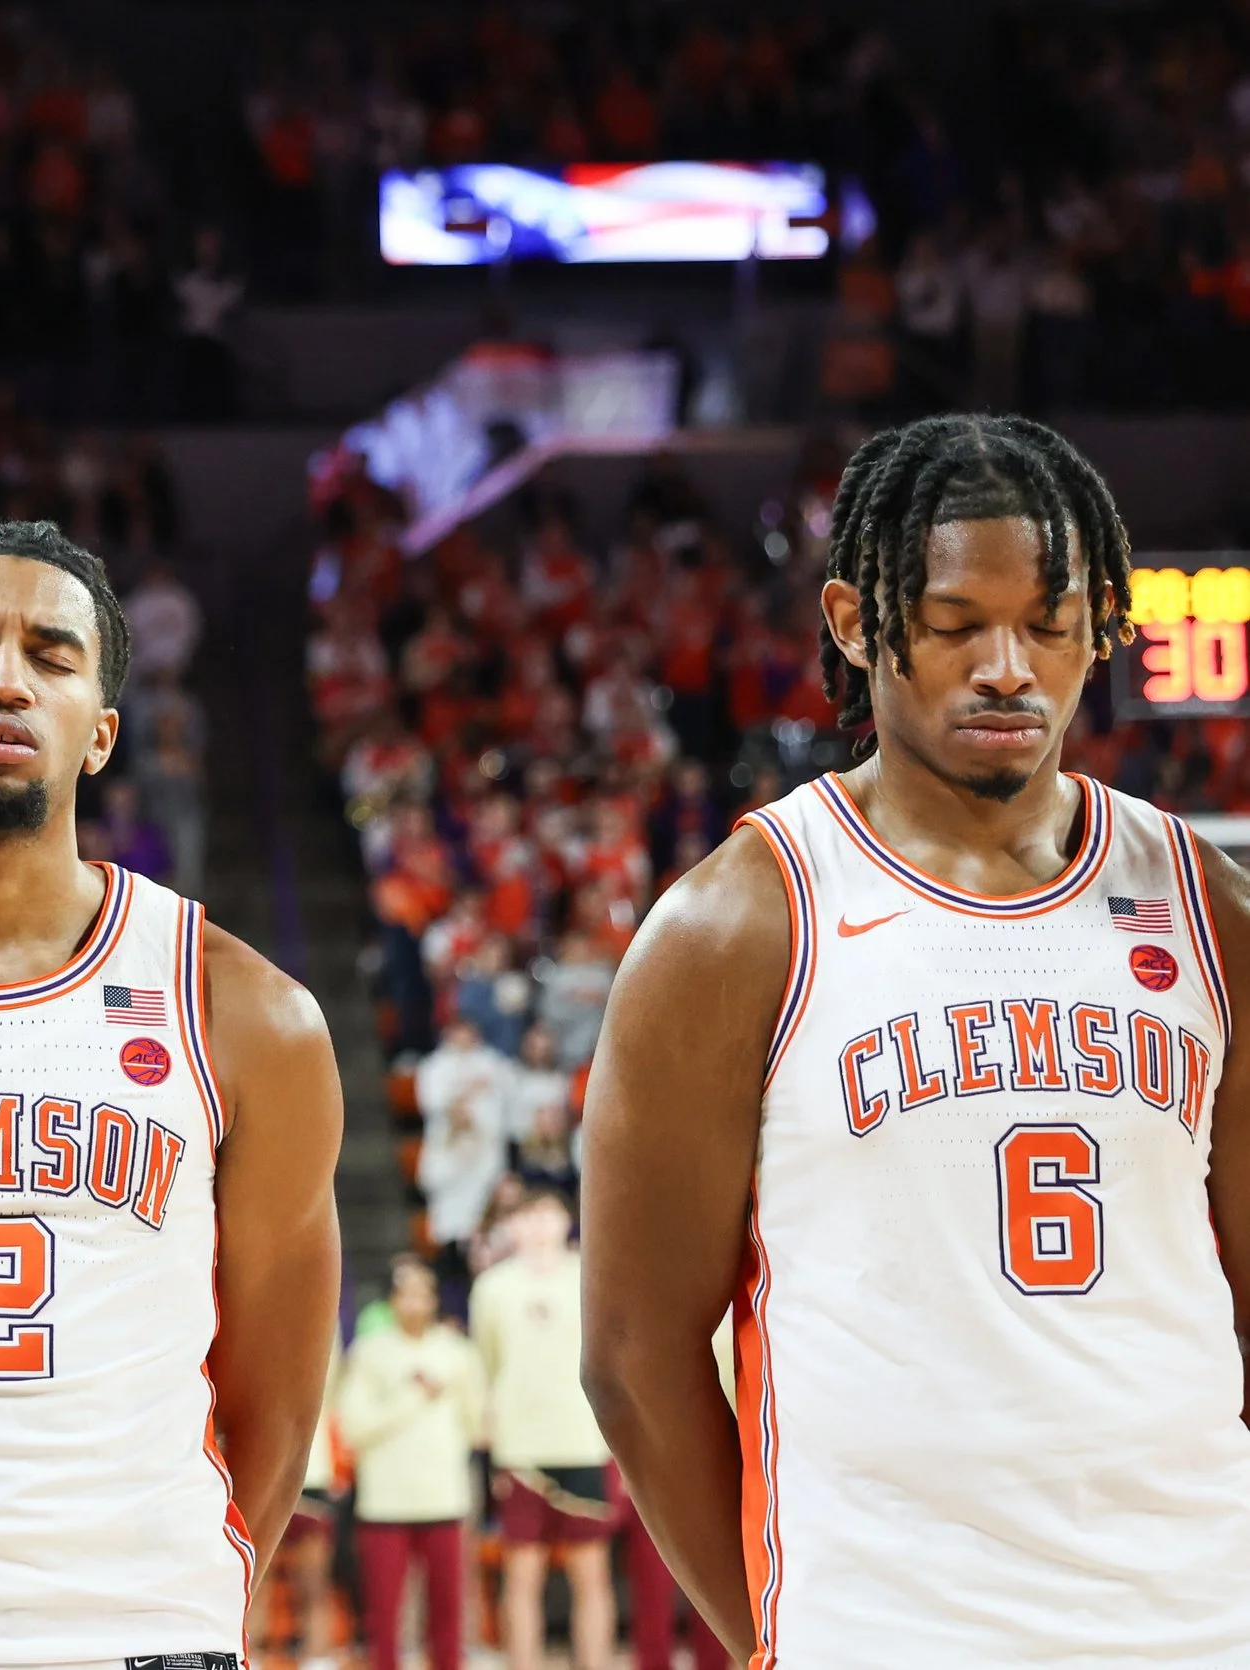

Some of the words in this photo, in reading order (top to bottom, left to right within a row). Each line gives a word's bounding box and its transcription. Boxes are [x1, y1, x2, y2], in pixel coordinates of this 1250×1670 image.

[1141, 620, 1248, 703] 30
[838, 998, 1211, 1145] CLEMSON
[994, 1123, 1105, 1296] 6
